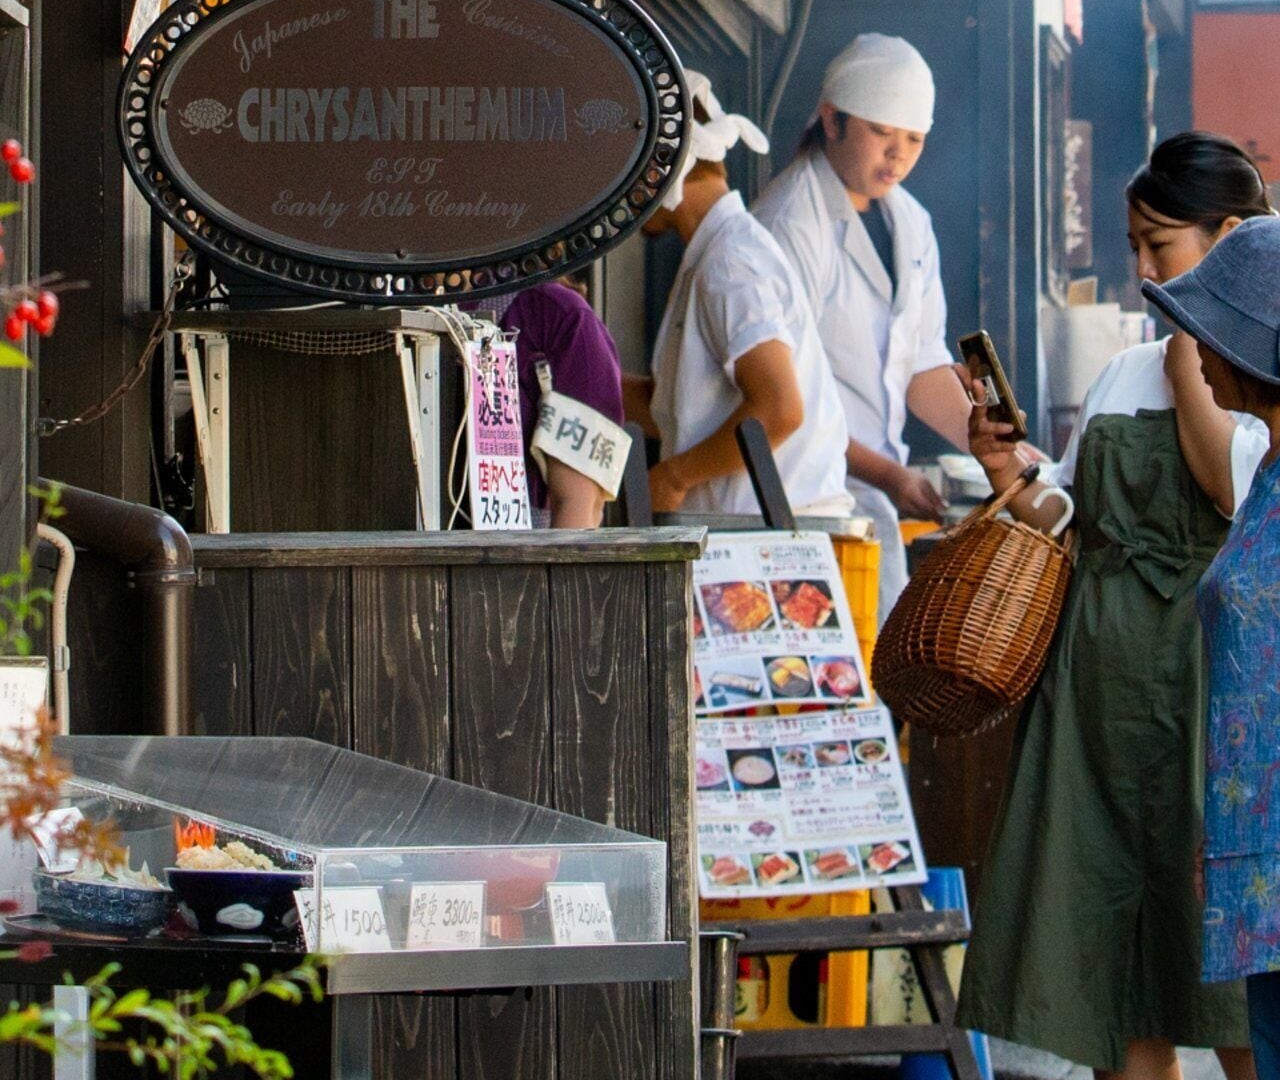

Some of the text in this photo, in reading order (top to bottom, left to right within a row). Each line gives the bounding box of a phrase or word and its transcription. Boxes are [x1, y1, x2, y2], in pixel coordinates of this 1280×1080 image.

[232, 6, 353, 73] Japanese
[237, 86, 567, 142] CHRYSANTHEMUM
[270, 189, 531, 228] Early 18th Century
